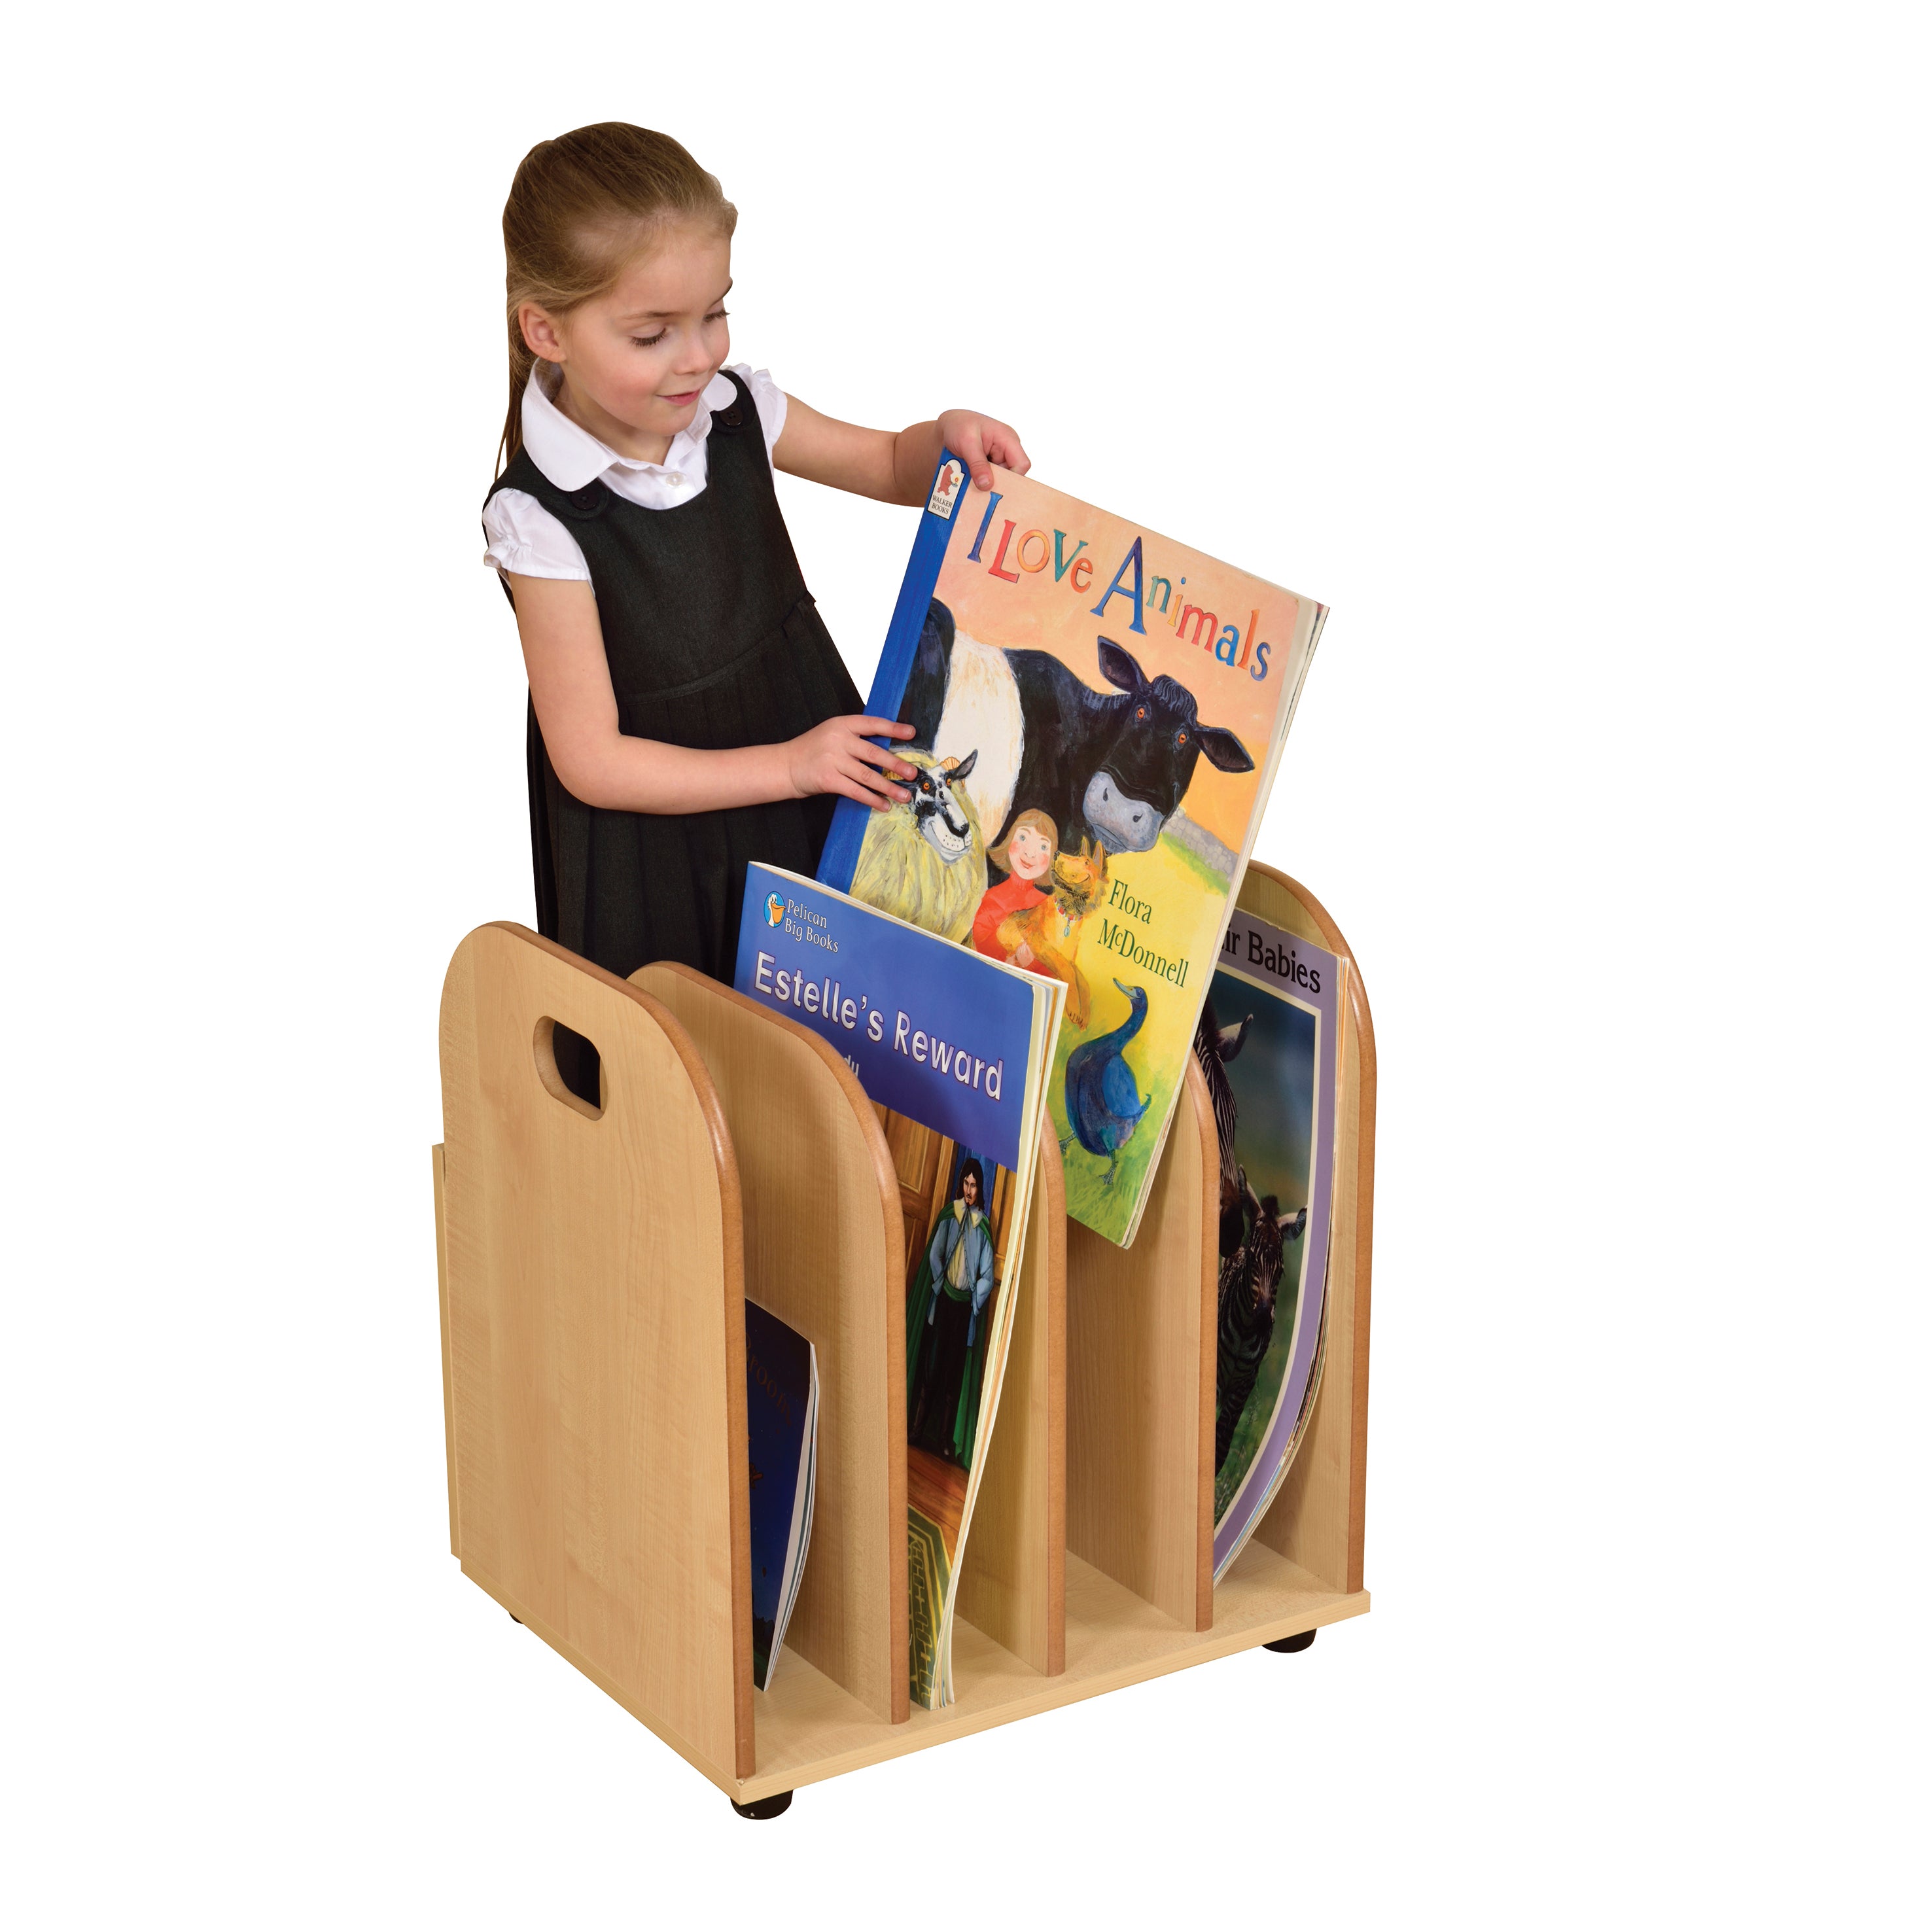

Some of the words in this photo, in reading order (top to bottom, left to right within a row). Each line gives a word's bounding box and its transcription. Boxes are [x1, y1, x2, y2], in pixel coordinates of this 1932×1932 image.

[932, 495, 953, 508] WALKER
[932, 502, 949, 514] BOOKS
[967, 491, 1003, 563] I
[1090, 536, 1271, 682] Animals
[786, 899, 828, 930] Pelican
[1108, 879, 1152, 924] Flora
[784, 917, 803, 942] Big
[806, 926, 839, 953] Books
[1097, 918, 1189, 988] McDonnell
[1248, 930, 1321, 994] Babies
[754, 950, 885, 1042] Estelle's
[894, 1010, 1004, 1102] Reward
